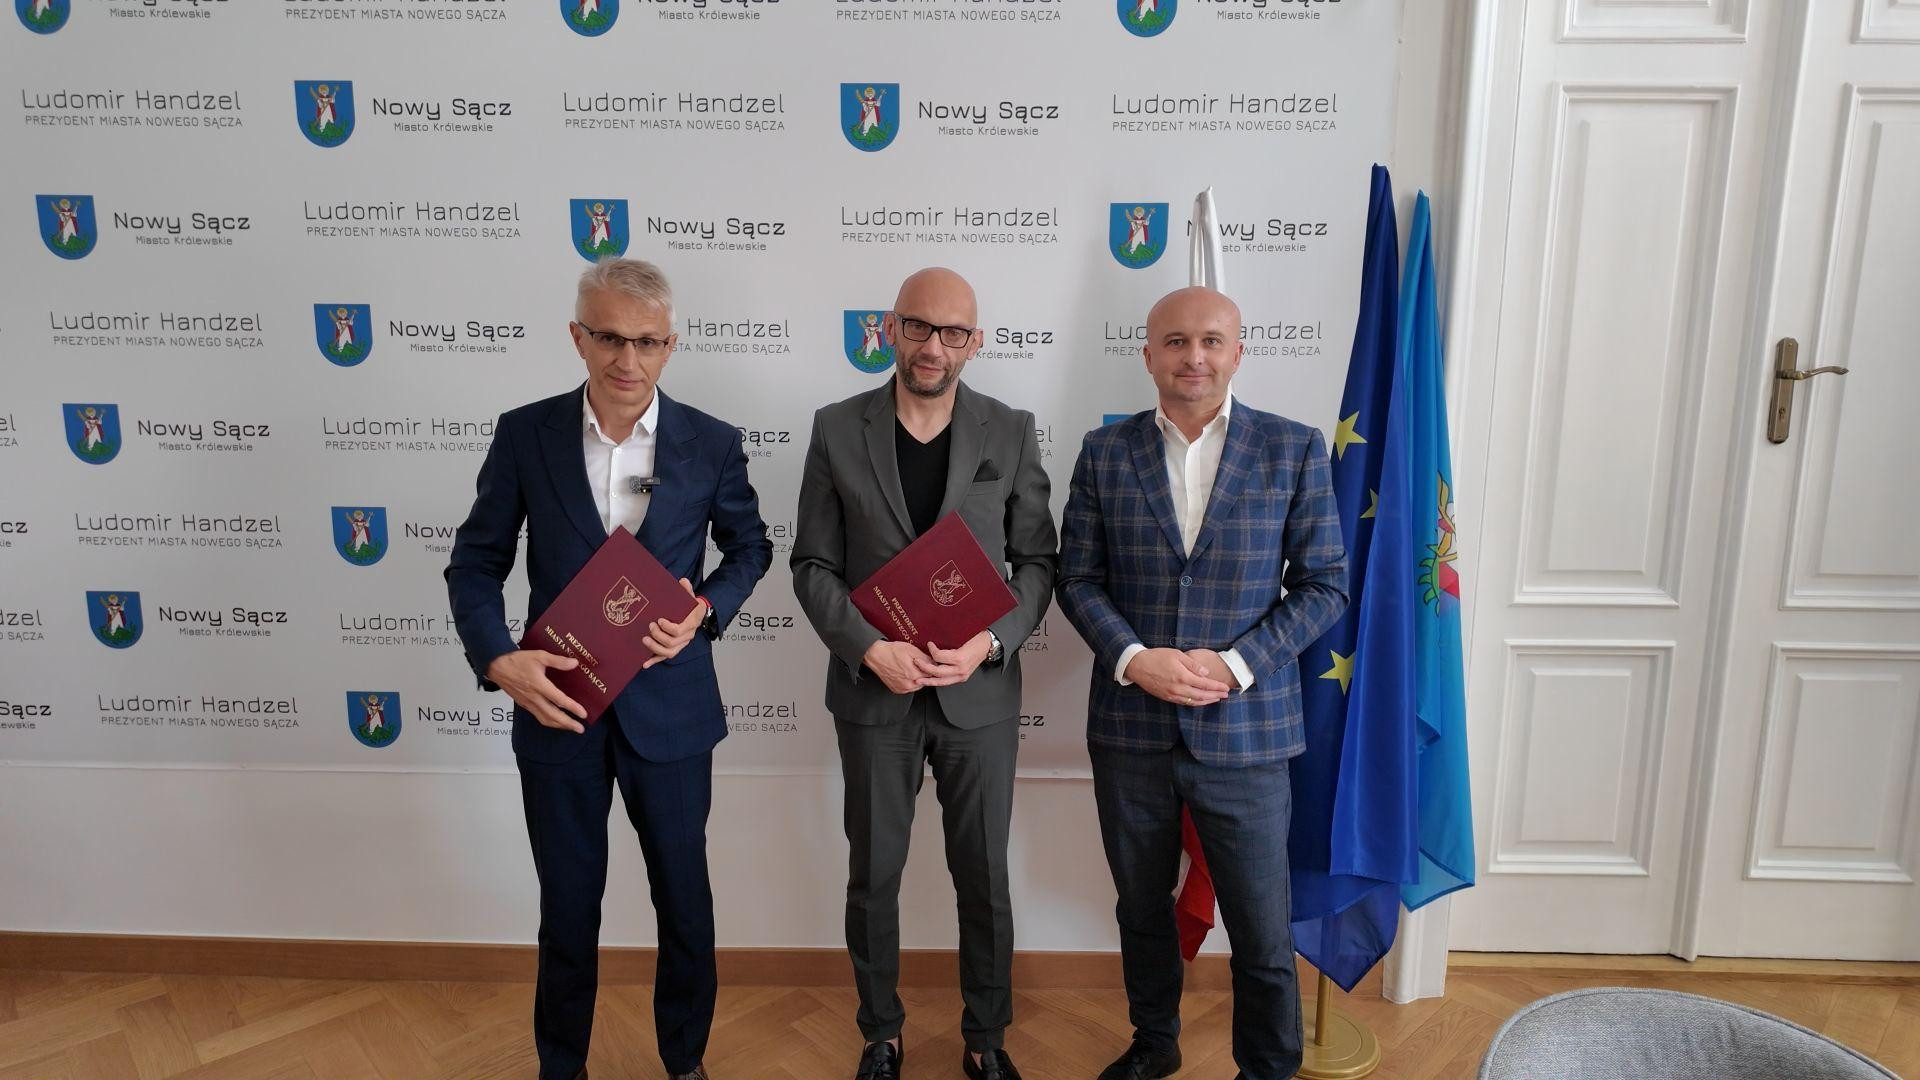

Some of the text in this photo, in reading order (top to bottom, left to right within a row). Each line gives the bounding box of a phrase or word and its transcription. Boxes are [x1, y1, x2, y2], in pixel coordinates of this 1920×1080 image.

[110, 8, 211, 19] Miasto Królewskie
[286, 8, 507, 22] PREZYDENT MIASTA NOWEGO SĄCZA
[658, 10, 761, 21] Miasto Królewskie
[836, 9, 1061, 23] PREZYDENT MIASTA NOWEGO SĄCZA
[1217, 9, 1320, 21] Miasto Królewskie
[22, 89, 241, 111] Ludomir Handzel
[564, 92, 785, 114] Ludomir Handzel
[1113, 93, 1338, 115] Ludomir Handzel
[372, 98, 512, 121] Nowy Sącz
[918, 101, 1059, 125] Nowy Sącz
[26, 115, 243, 129] PREZYDENT MIASTA NOWEGO SĄCZA
[394, 120, 494, 133] Miasto Królewskie
[565, 118, 785, 133] PREZYDENT MIASTA NOWEGO SĄCZA
[1112, 120, 1336, 133] PREZYDENT MIASTA NOWEGO SĄCZA
[938, 125, 1039, 136] Miasto Królewskie
[304, 201, 520, 223] Ludomir Handzel
[842, 206, 1058, 228] Ludomir Handzel
[114, 212, 251, 235] Nowy Sącz
[648, 216, 786, 240] Nowy Sącz
[1266, 218, 1328, 243] Sącz
[307, 226, 521, 240] PREZYDENT MIASTA NOWEGO SĄCZA
[842, 231, 1058, 246] PREZYDENT MIASTA NOWEGO SĄCZA
[136, 236, 232, 246] Miasto Królewskie
[668, 240, 767, 251] Miasto Królewskie
[1222, 242, 1306, 253] sto Królewskie
[50, 312, 262, 332] Ludomir Handzel
[688, 318, 790, 339] Handzel
[390, 320, 525, 343] Nowy Sącz
[994, 328, 1053, 349] Sącz
[53, 336, 264, 349] PREZYDENT MIASTA NOWEGO SĄCZA
[410, 343, 507, 353] Miasto Królewskie
[696, 343, 750, 353] NOWEGO
[752, 344, 790, 356] SĄCZA
[1104, 345, 1142, 356] PREZY
[1242, 346, 1321, 358] WEGO SĄCZA
[138, 420, 270, 441] Nowy Sącz
[323, 416, 494, 436] Ludomir Hand
[158, 442, 253, 452] Miasto Królewskie
[325, 440, 391, 451] PREZYDENT
[396, 441, 436, 452] MIASTA
[76, 513, 281, 534] Ludomir Handzel
[78, 536, 282, 550] PREZYDENT MIASTA NOWEGO SĄCZA
[158, 606, 288, 628] Nowy Sącz
[340, 613, 436, 633] Ludomir
[739, 613, 794, 631] Sącz
[891, 597, 919, 636] PREZYDENT
[8, 632, 44, 642] SĄCZA
[180, 627, 271, 638] Miasto Królewskie
[342, 635, 407, 645] PREZYDENT
[411, 636, 450, 646] MIASTA
[565, 632, 598, 666] PREZYDENT
[544, 625, 608, 694] MIASTA NOGO SĄCZA
[98, 694, 298, 714] Ludomir Handzel
[102, 716, 299, 729] PREZYDENT MIASTA NOWEGO SĄCZA
[418, 706, 481, 727] Nowy
[438, 727, 470, 736] Miasto
[761, 723, 798, 734] SĄCZA
